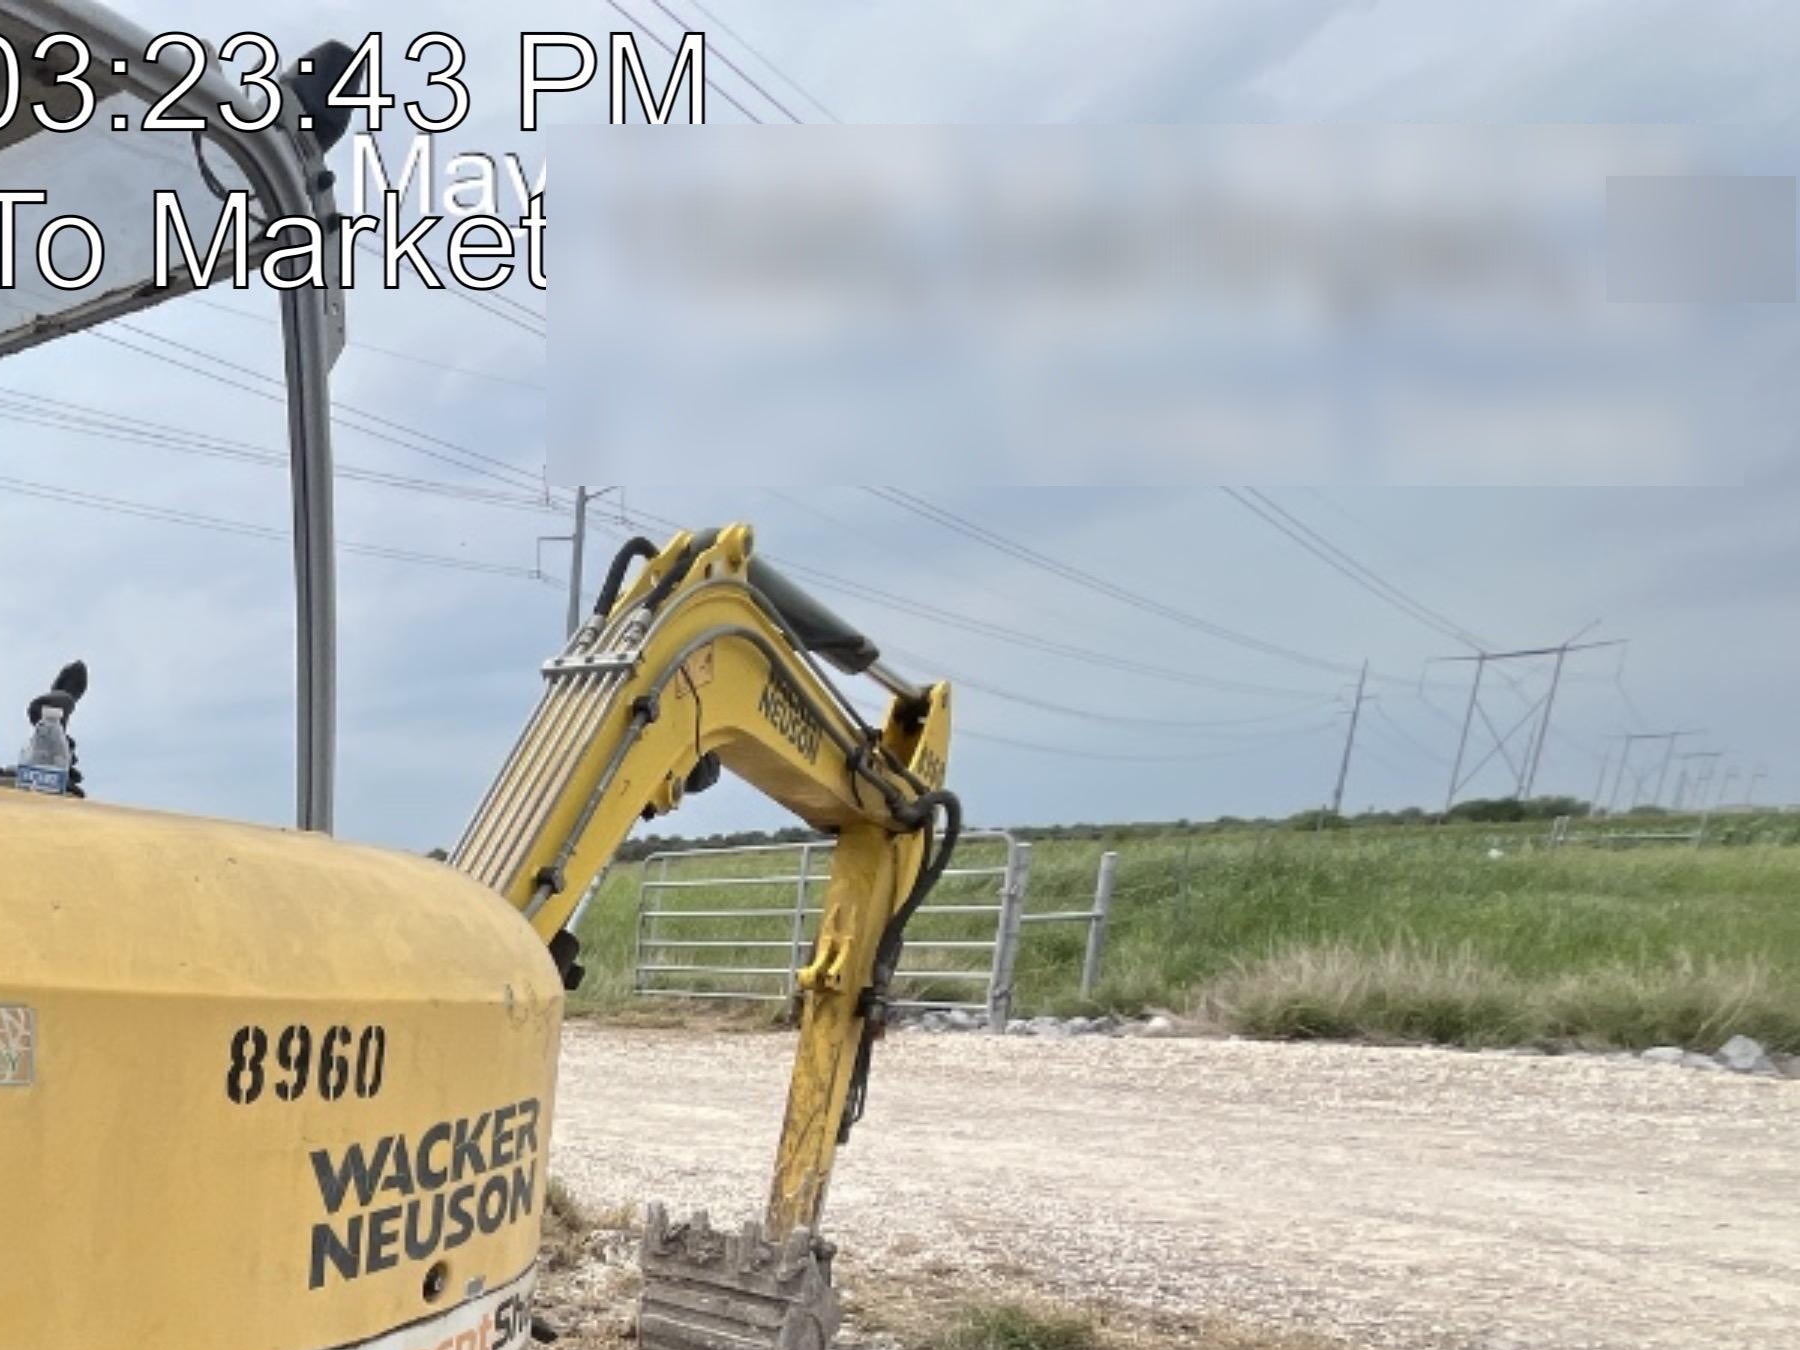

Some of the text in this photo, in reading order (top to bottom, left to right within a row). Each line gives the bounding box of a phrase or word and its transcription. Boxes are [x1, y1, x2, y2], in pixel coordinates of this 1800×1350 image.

[226, 1024, 386, 1105] 8960
[308, 1097, 541, 1215] WACKER
[308, 1157, 538, 1290] NEUSON
